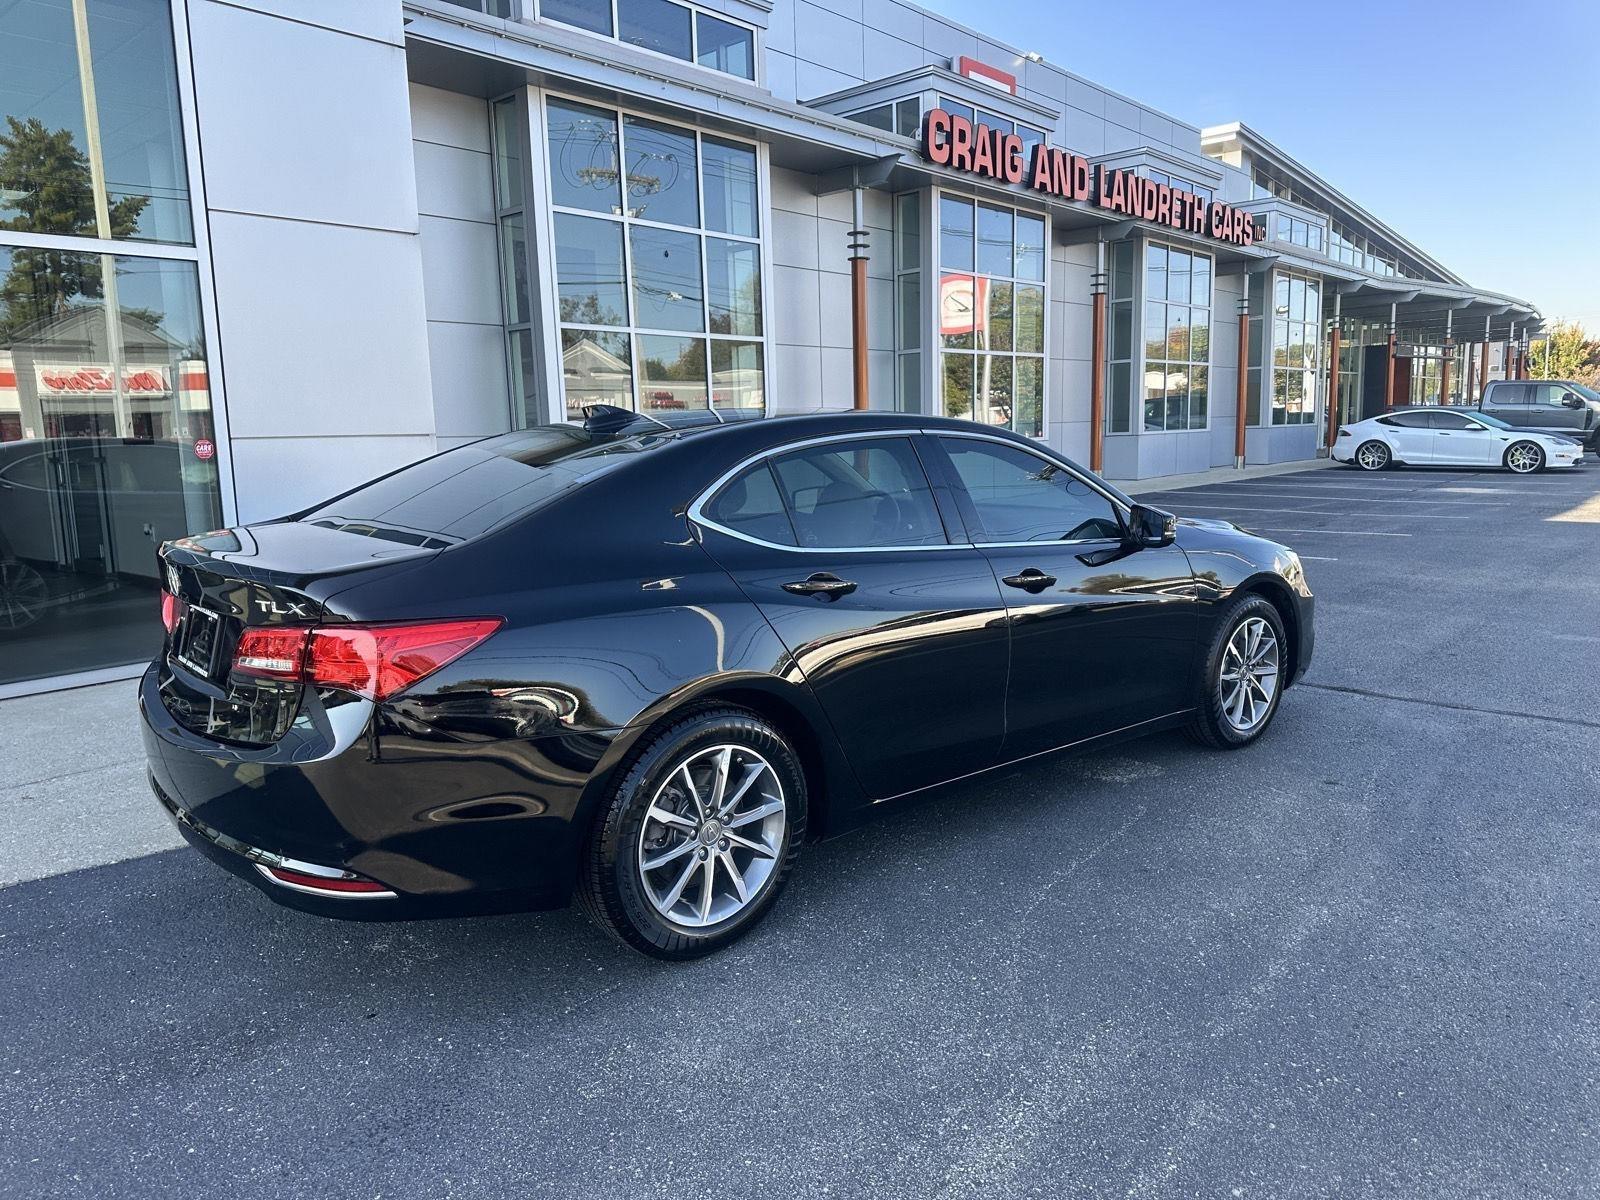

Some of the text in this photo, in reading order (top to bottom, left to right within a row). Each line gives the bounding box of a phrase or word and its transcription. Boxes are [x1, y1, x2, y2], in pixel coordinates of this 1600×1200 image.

[924, 108, 1023, 184] CRAIG
[1031, 144, 1090, 201] AND
[1095, 164, 1206, 234] LANDRETH
[1208, 201, 1253, 246] CARS
[255, 599, 306, 616] TLX
